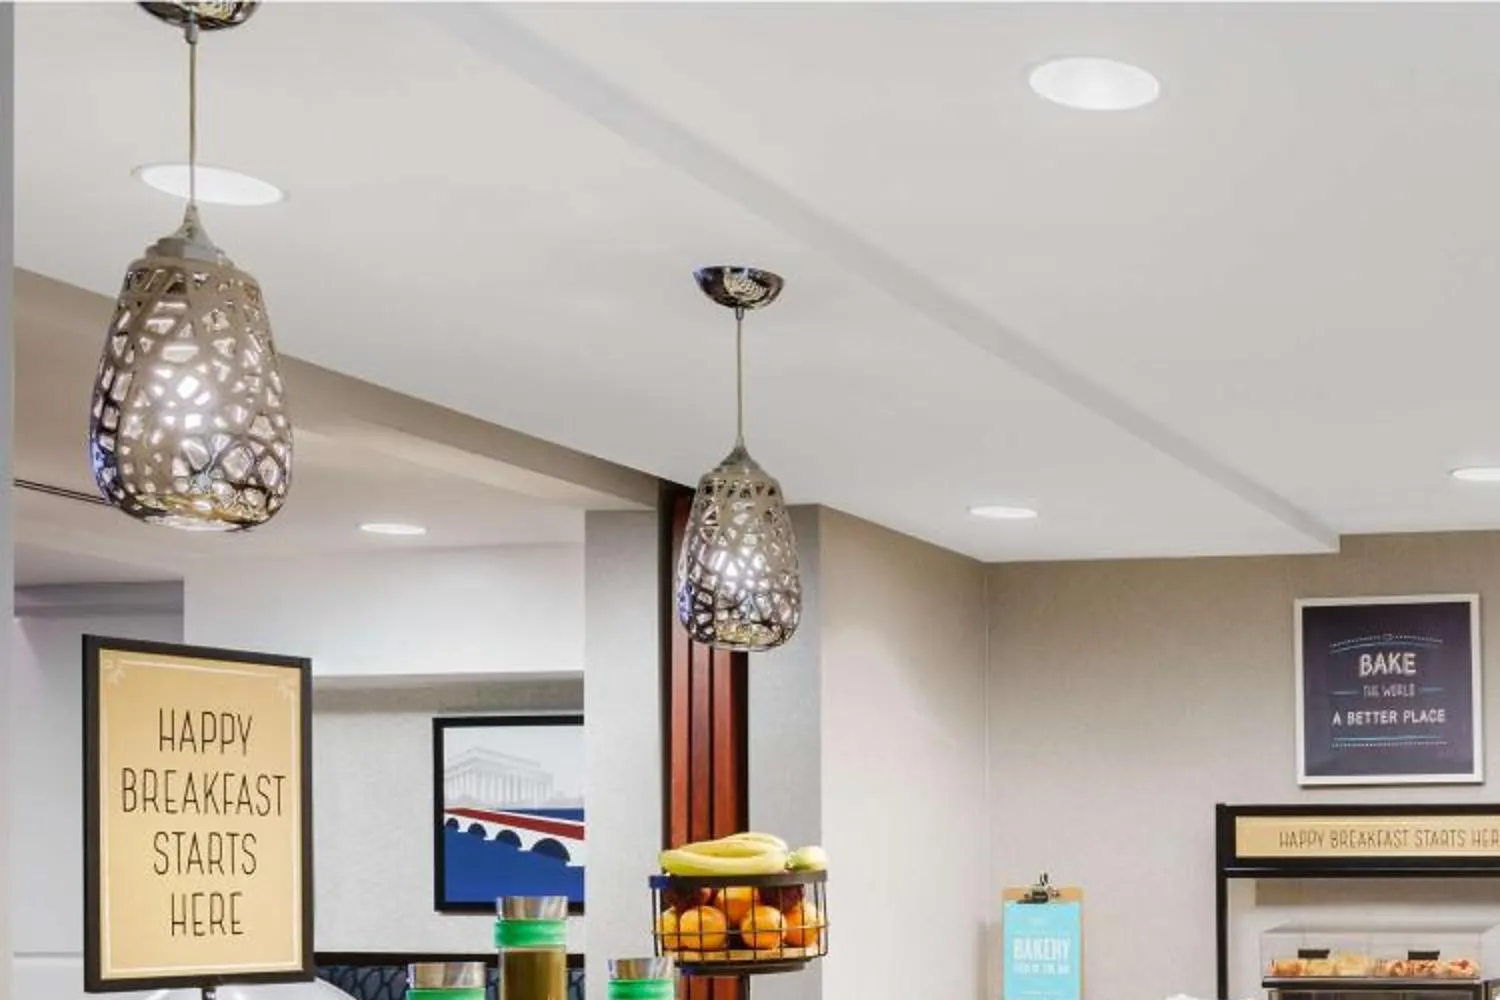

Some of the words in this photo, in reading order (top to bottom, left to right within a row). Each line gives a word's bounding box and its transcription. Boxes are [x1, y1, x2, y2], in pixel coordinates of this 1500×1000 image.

[1358, 651, 1417, 678] BAKE
[1362, 684, 1379, 698] THE
[1381, 683, 1416, 698] WORLD
[1331, 711, 1342, 726] A
[1347, 709, 1398, 726] BETTER
[1403, 708, 1447, 724] PLACE
[159, 707, 253, 755] HAPPY
[121, 767, 287, 817] BREAKFAST
[1279, 830, 1325, 849] HAPPY
[1329, 829, 1409, 849] BREAKFAST
[1414, 829, 1467, 848] STARTS
[153, 831, 258, 876] STARTS
[170, 892, 245, 937] HERE
[1013, 936, 1071, 961] BAKERY
